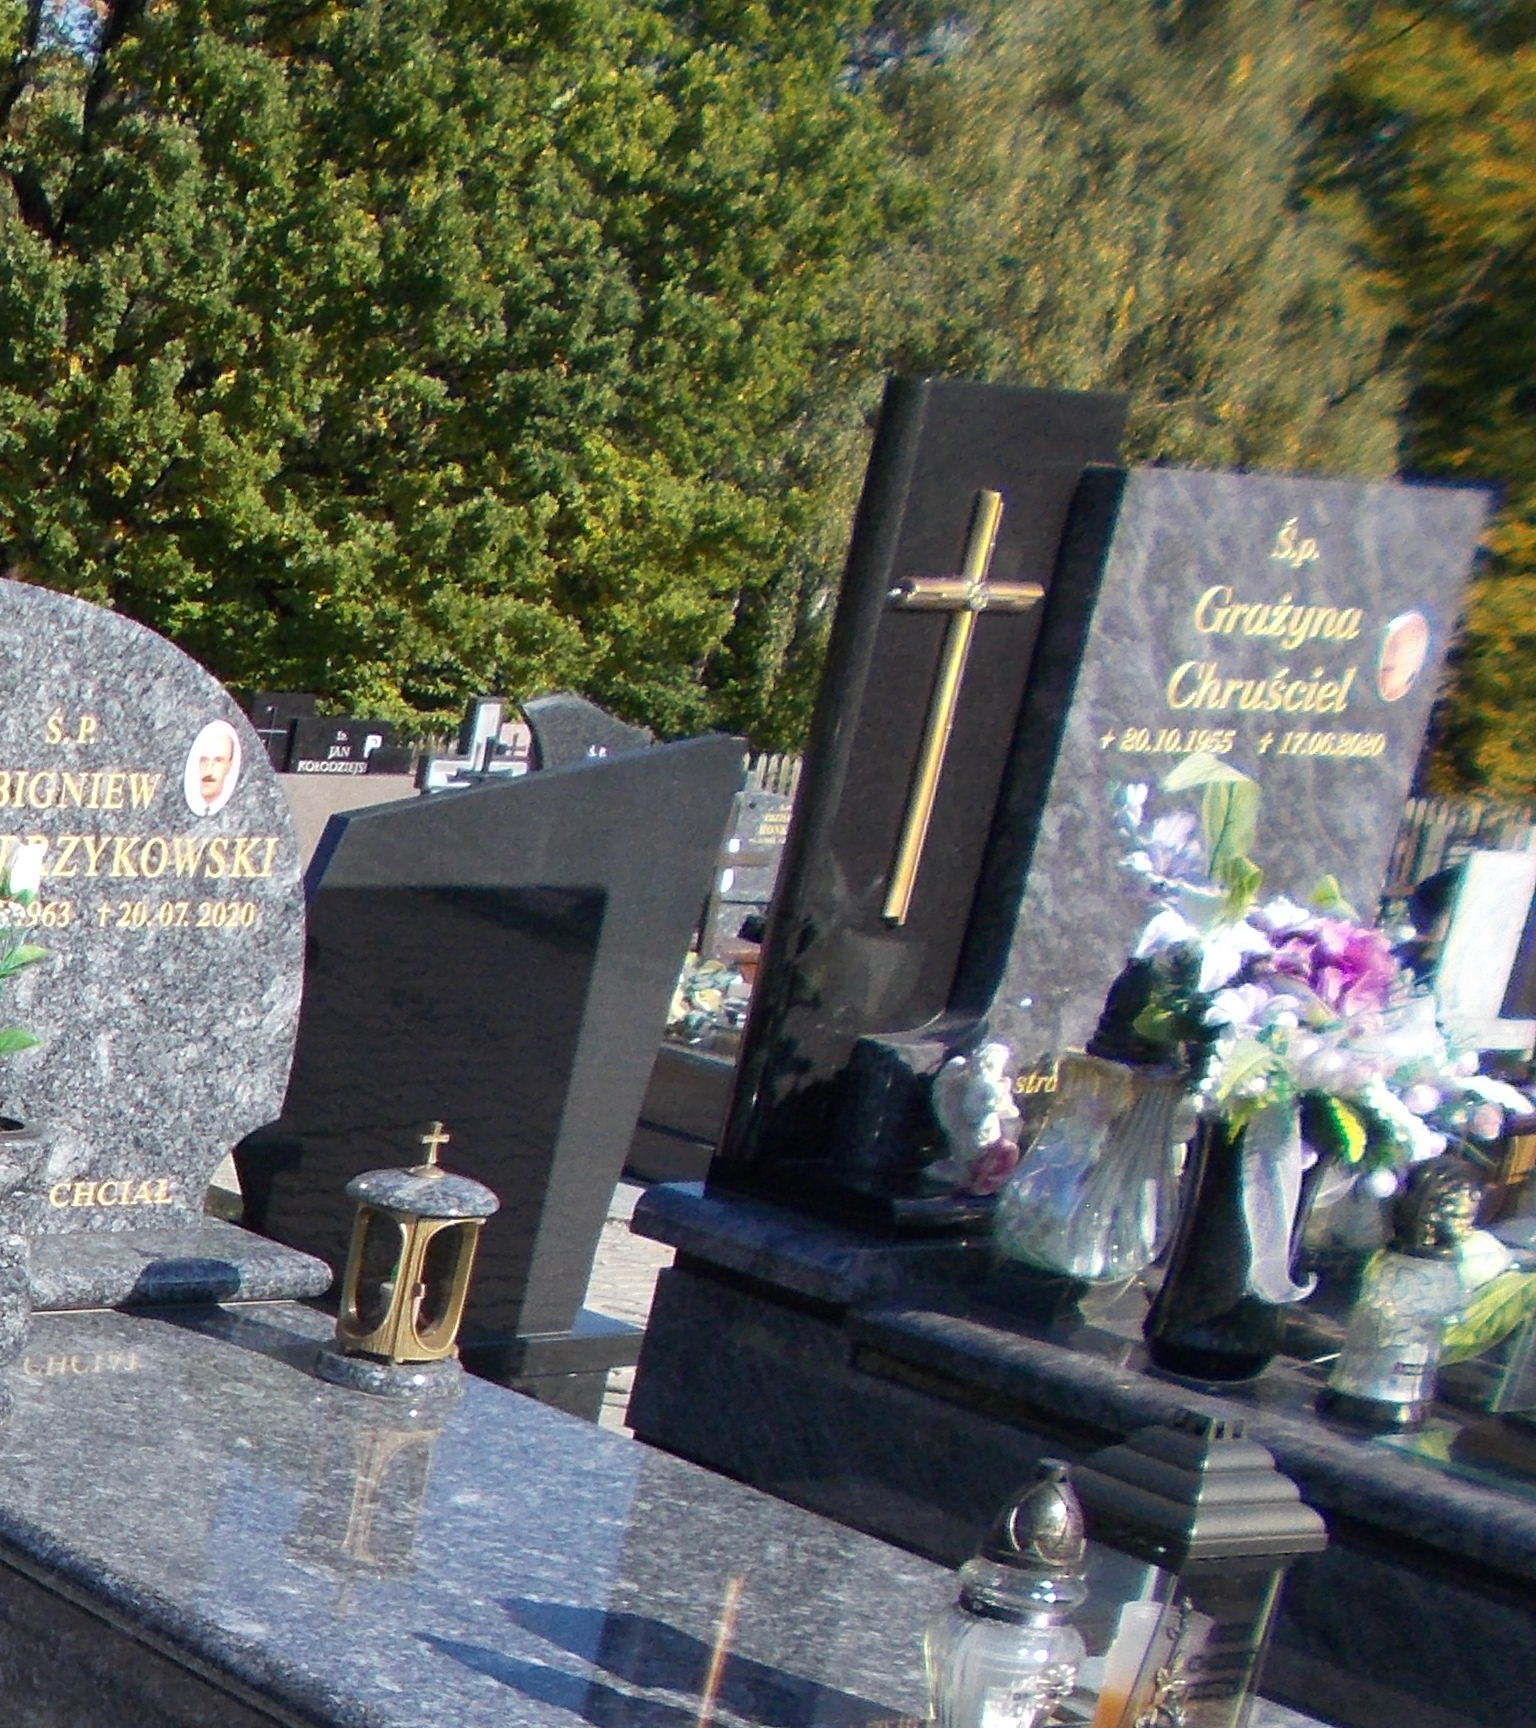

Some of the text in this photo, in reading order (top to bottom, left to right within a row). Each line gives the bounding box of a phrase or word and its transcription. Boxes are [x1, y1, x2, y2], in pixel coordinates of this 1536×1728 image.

[1194, 585, 1364, 650] Grażyna
[1167, 660, 1358, 713] Chruściel
[328, 745, 352, 760] JAN
[48, 1178, 173, 1208] CHCIAŁ
